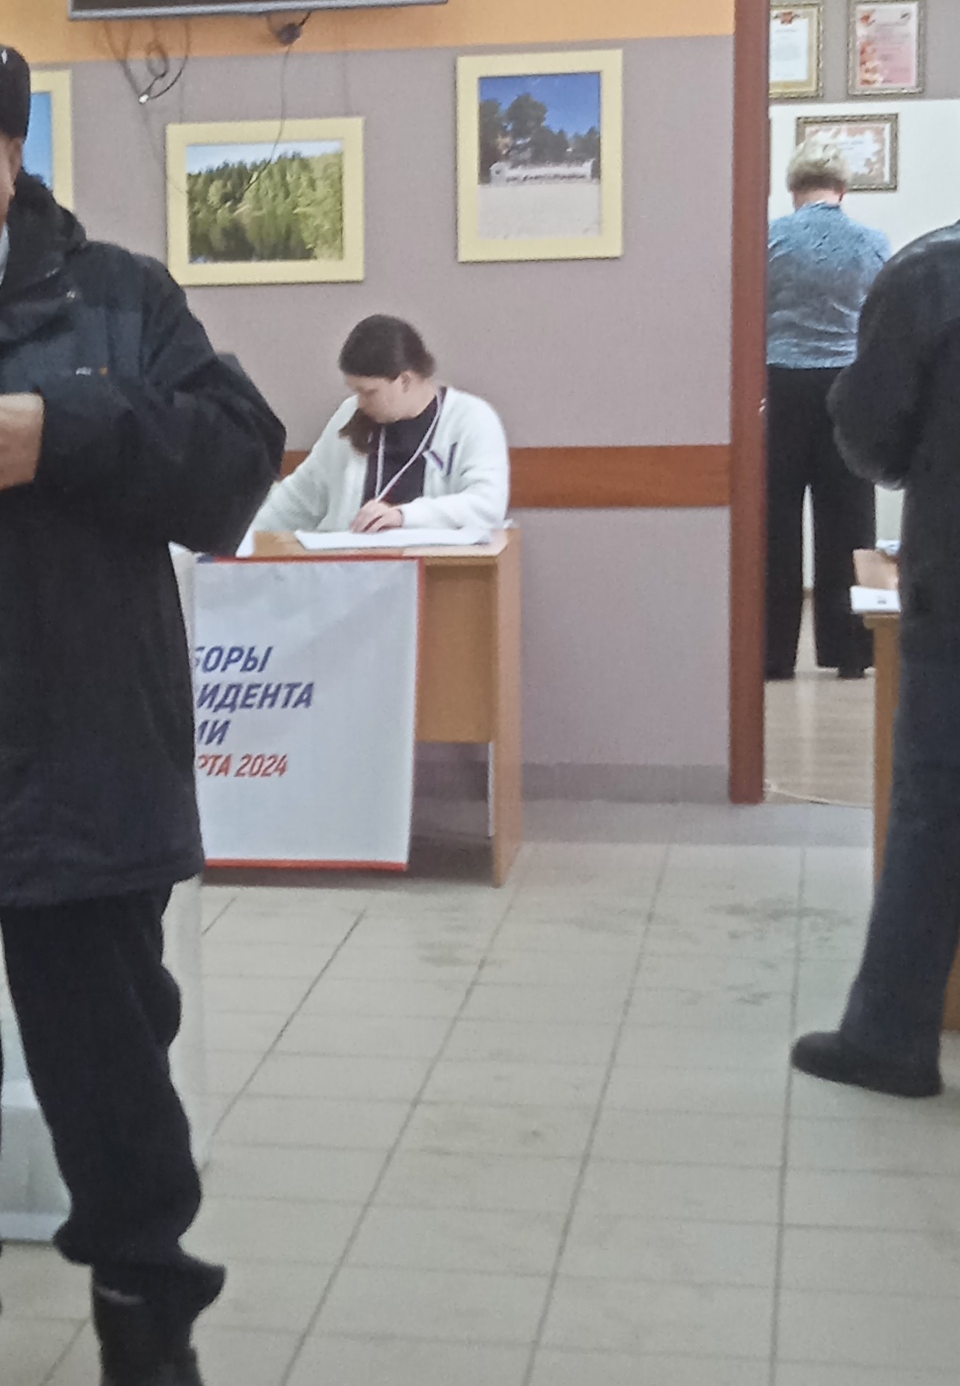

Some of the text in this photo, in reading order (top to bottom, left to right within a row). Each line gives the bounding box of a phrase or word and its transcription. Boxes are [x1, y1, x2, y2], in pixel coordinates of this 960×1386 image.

[197, 682, 314, 713] ИДЕНТА
[197, 719, 231, 745] ИИ
[197, 754, 288, 777] РТА 2024
